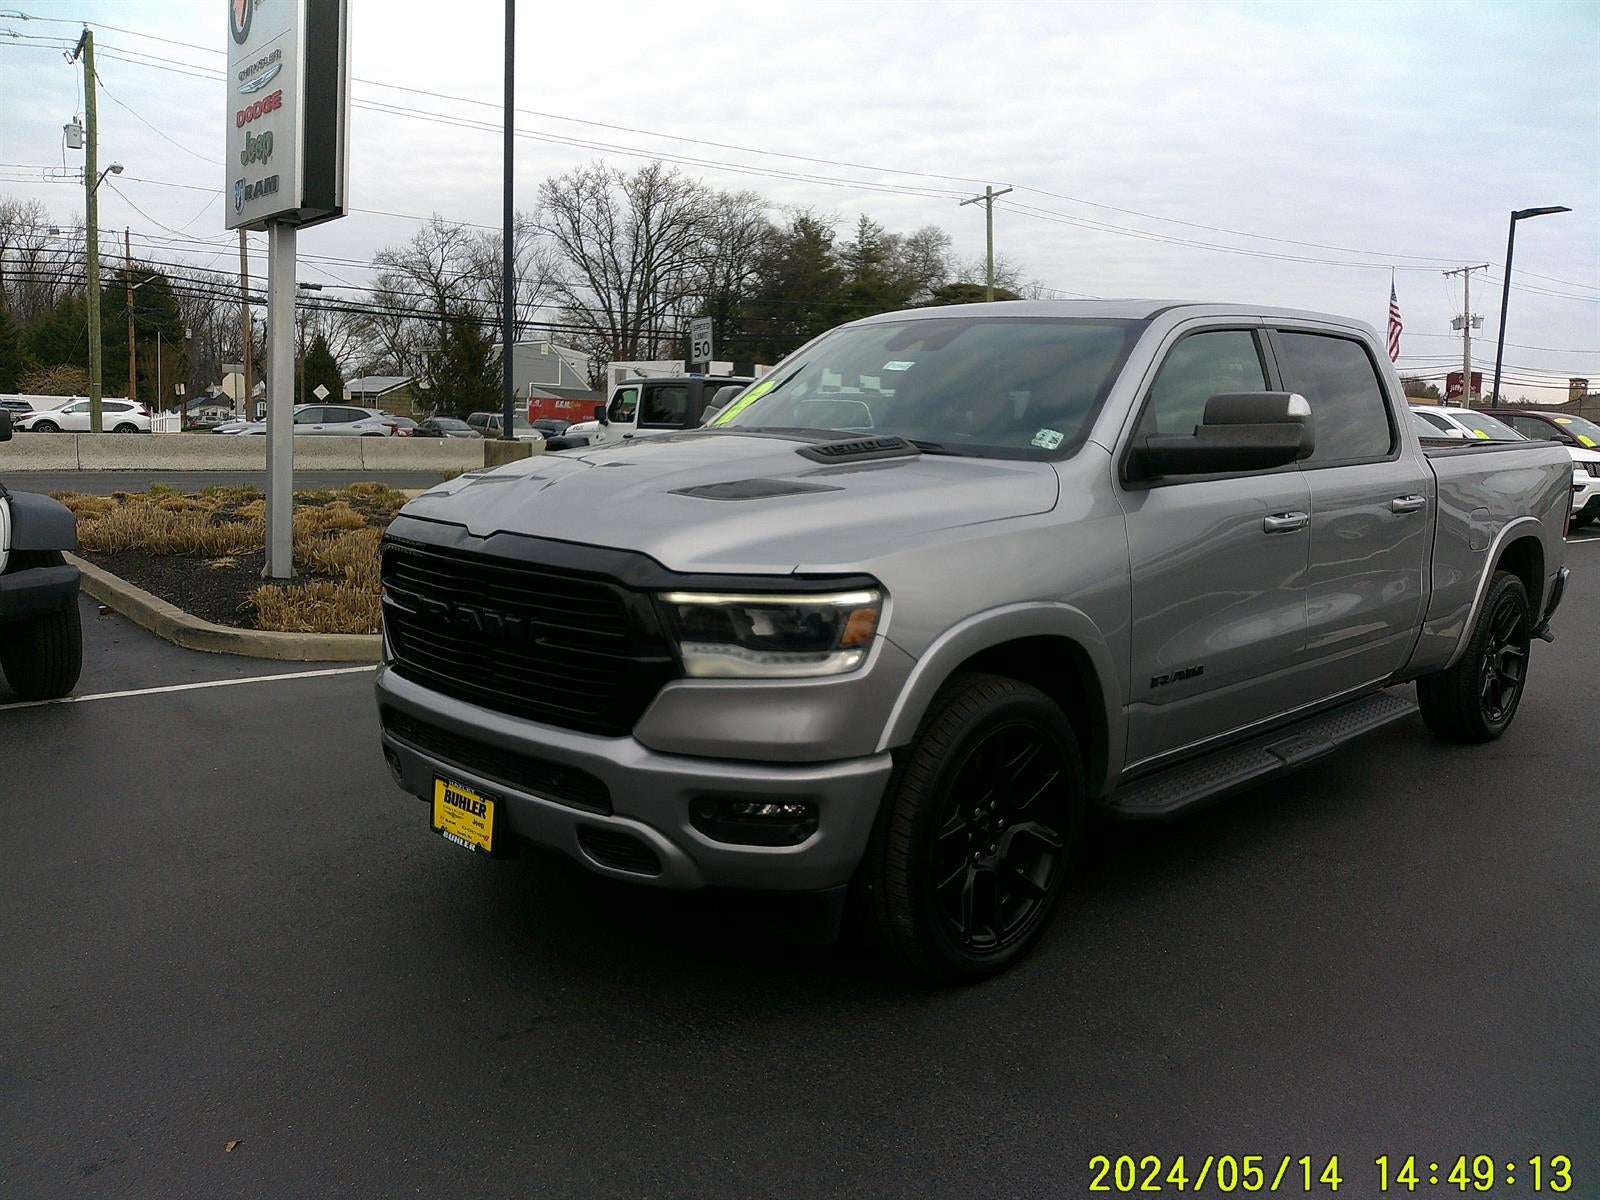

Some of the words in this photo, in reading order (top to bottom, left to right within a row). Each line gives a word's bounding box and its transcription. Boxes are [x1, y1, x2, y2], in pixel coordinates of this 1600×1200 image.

[238, 49, 282, 81] CHRYSLER
[236, 90, 283, 128] DODGE
[240, 131, 274, 166] Jeep
[244, 174, 280, 201] RAM
[694, 340, 710, 358] 50
[1150, 664, 1204, 689] RAM
[443, 789, 487, 820] BUHLER
[442, 831, 476, 852] BUHLER
